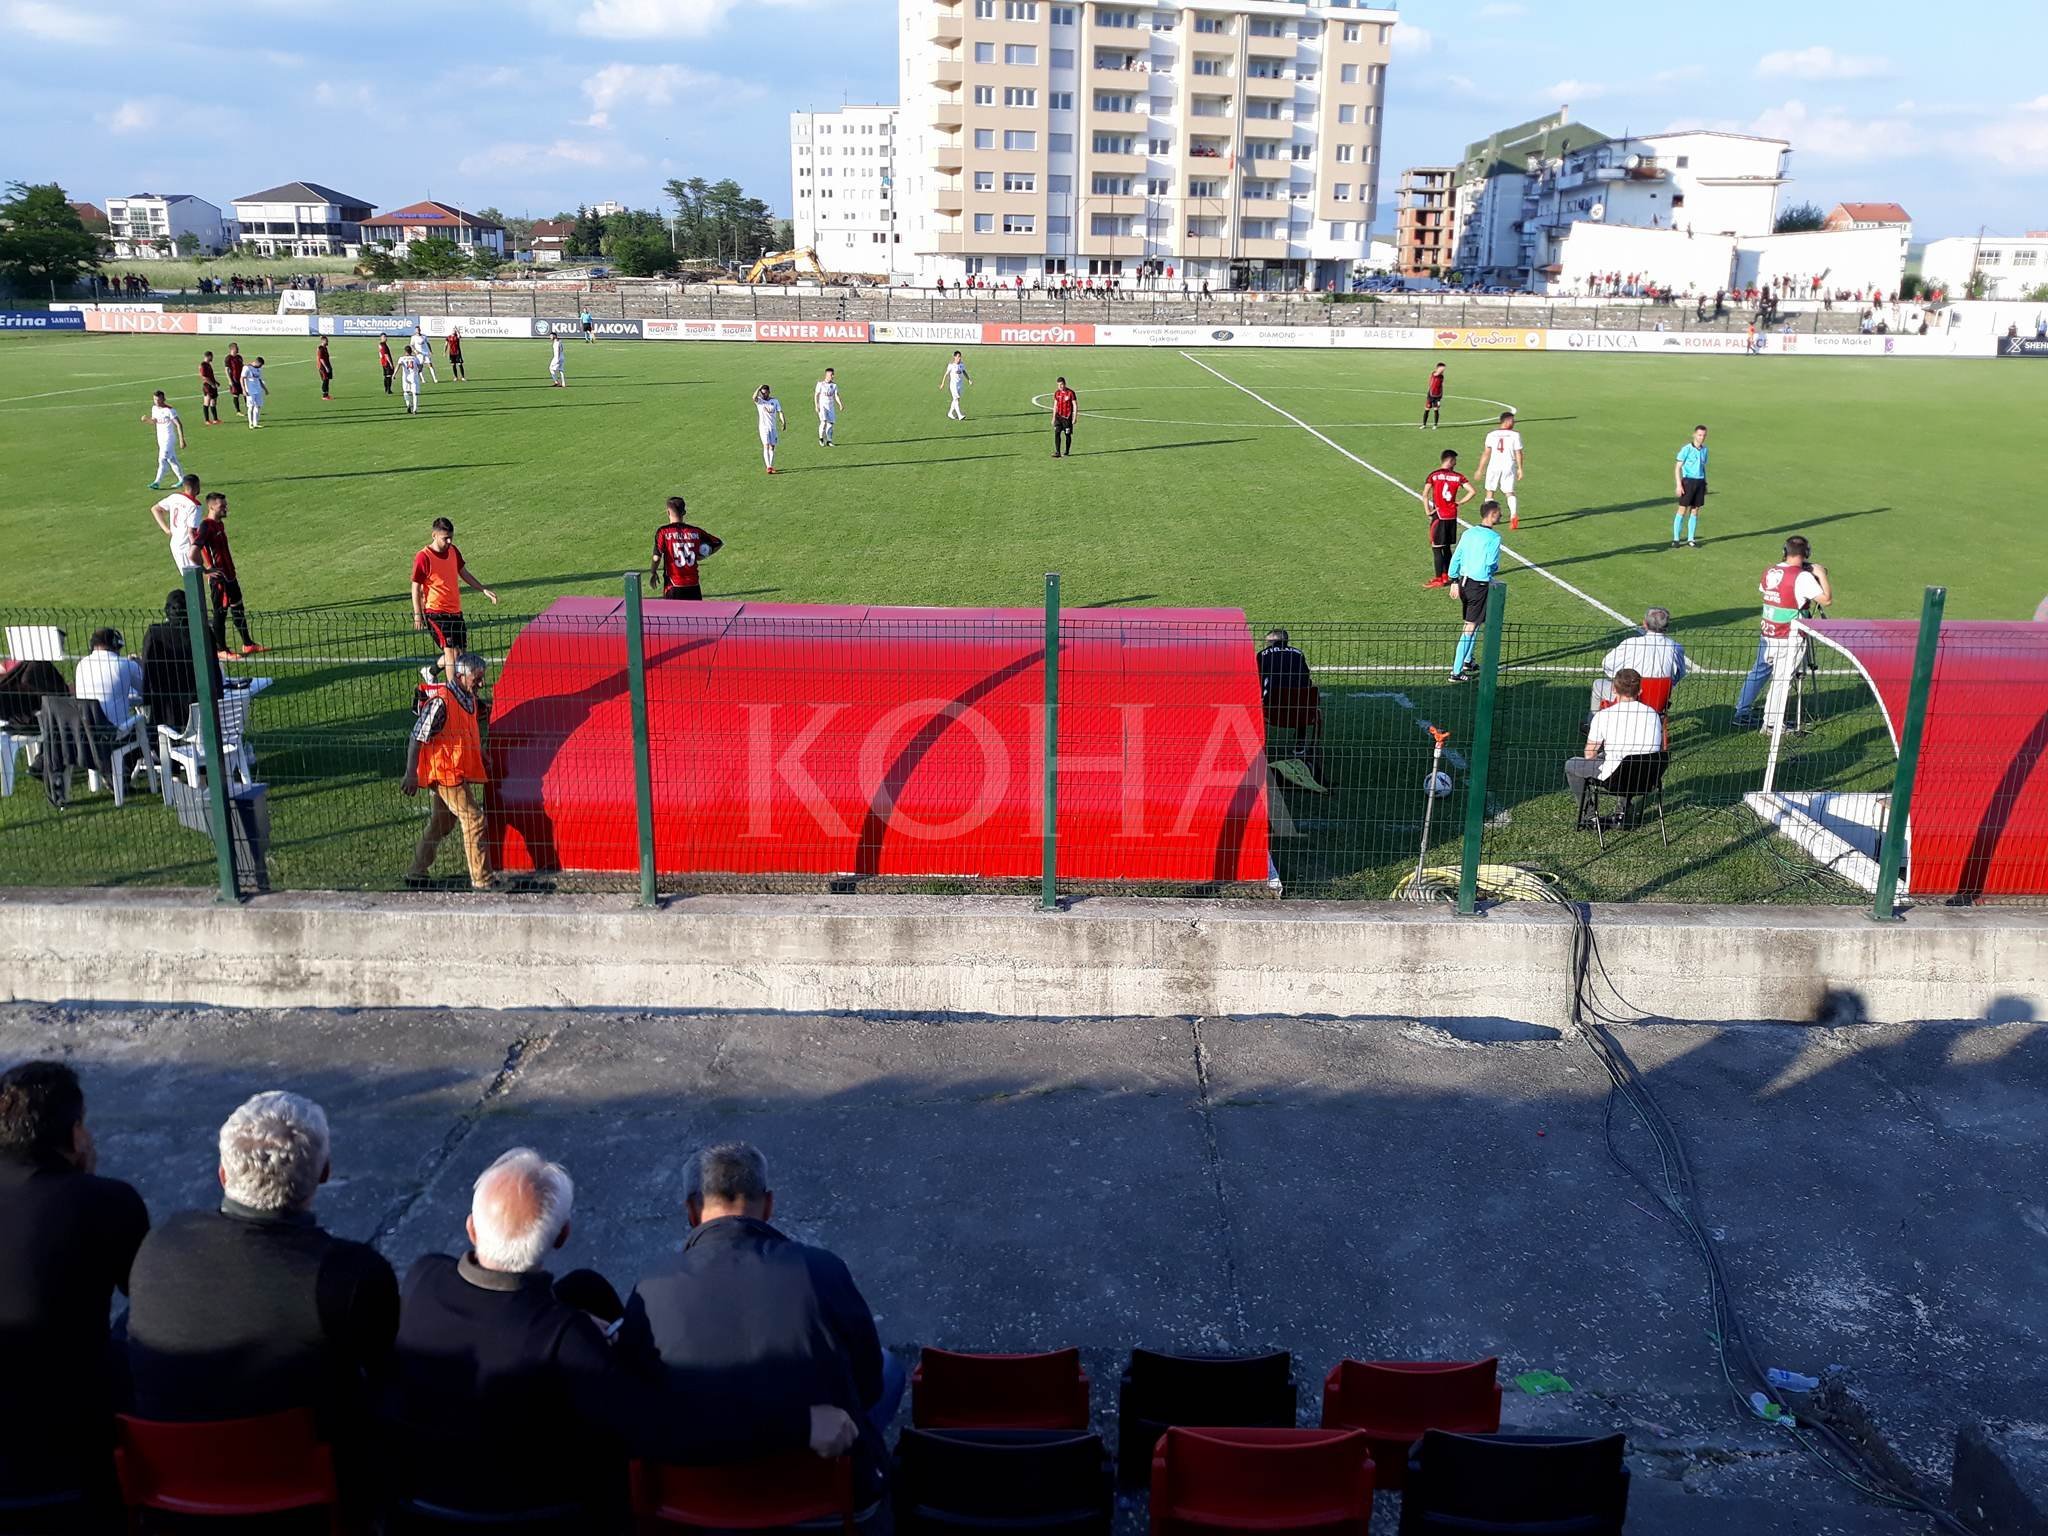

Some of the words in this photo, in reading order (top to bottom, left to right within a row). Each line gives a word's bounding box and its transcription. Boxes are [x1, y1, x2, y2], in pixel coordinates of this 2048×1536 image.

[100, 315, 184, 331] LINDEX
[469, 317, 498, 325] Banka
[458, 326, 509, 334] Ekonomike
[551, 322, 580, 334] KRU.
[585, 323, 639, 334] JAKOVA
[759, 325, 818, 338] CENTER
[823, 326, 865, 338] MALL
[896, 326, 923, 338] XENI
[926, 327, 978, 339] IMPERIAL
[1000, 326, 1076, 342] macron
[1258, 331, 1296, 339] DIAMOND
[1586, 333, 1638, 348] FINCA
[1814, 336, 1840, 345] Tecno
[1684, 337, 1721, 348] ROMA
[1496, 437, 1505, 454] 4
[672, 542, 696, 568] 55
